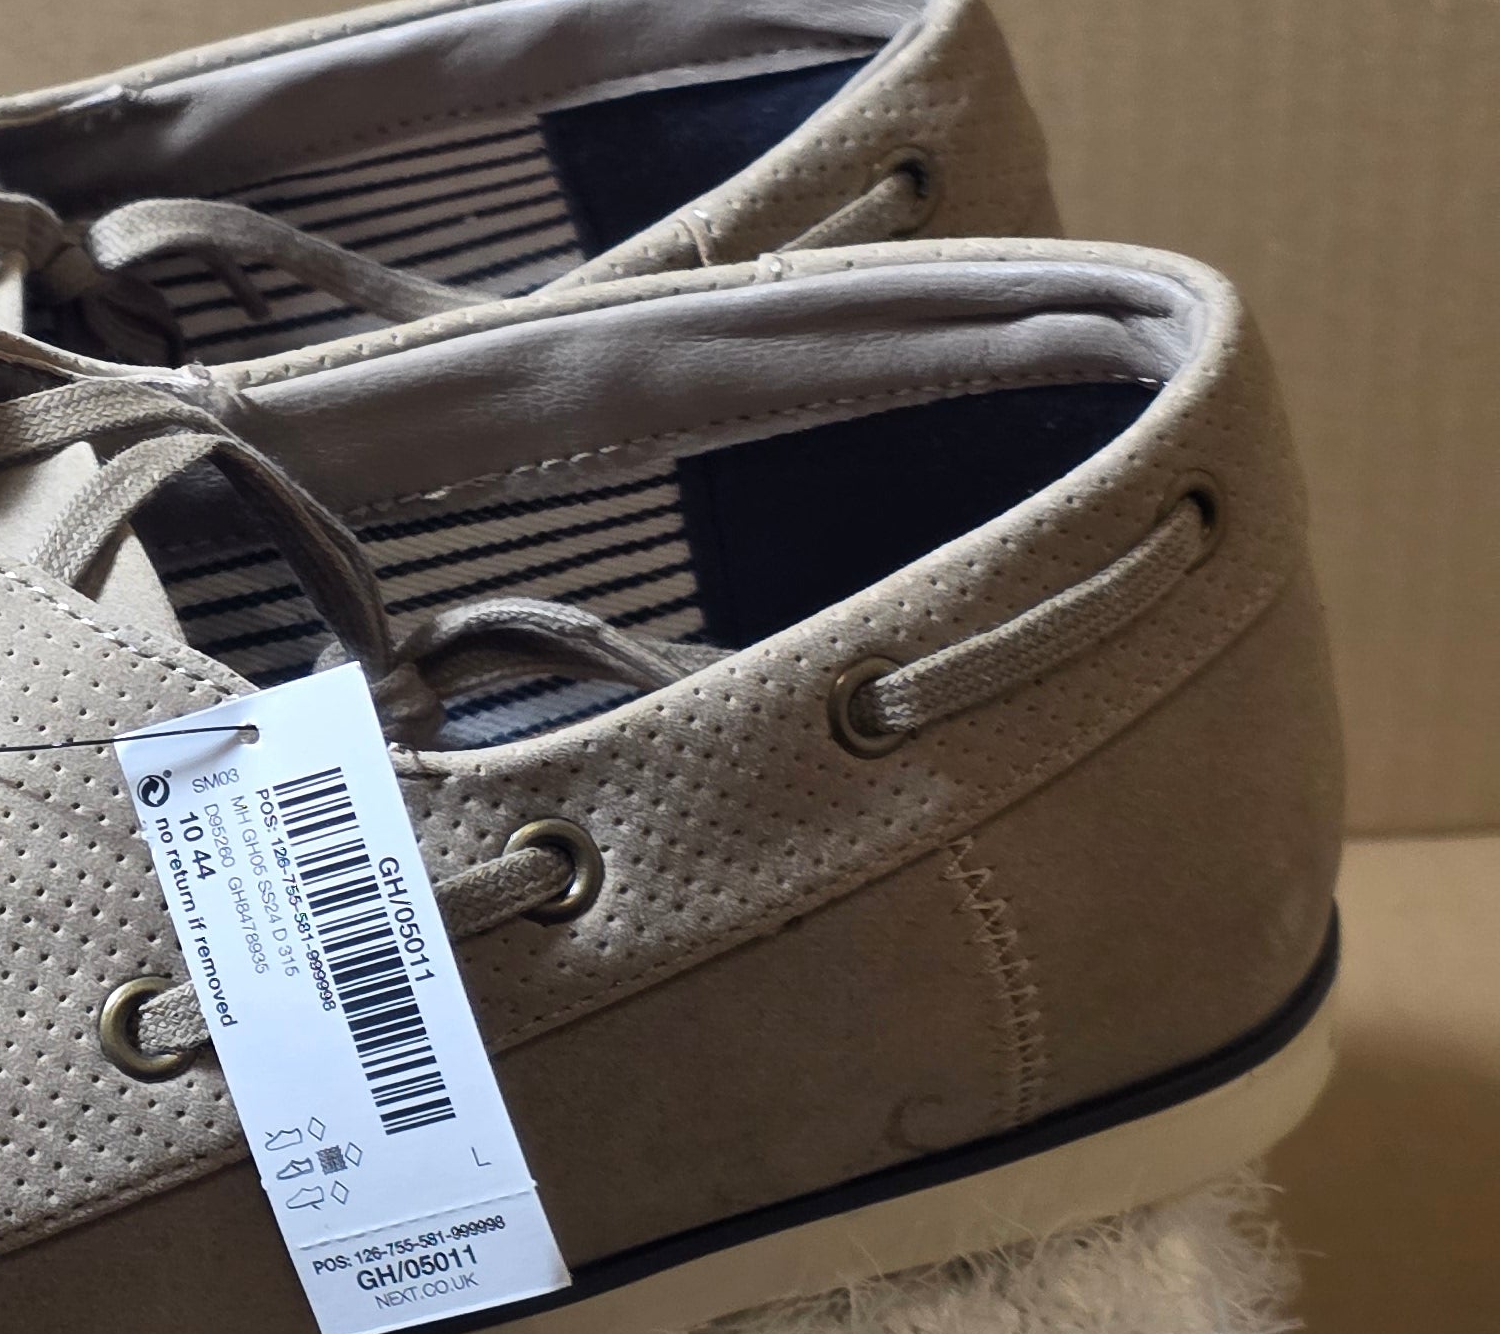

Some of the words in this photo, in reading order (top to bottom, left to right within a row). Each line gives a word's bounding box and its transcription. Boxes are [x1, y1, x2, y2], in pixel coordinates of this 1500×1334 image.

[192, 768, 240, 793] SM03
[156, 817, 174, 844] no
[179, 812, 204, 842] 10
[193, 850, 216, 880] 44
[204, 803, 235, 868] D95260
[166, 849, 196, 913] return
[231, 795, 252, 824] MH
[242, 828, 268, 876] GH05
[258, 880, 282, 924] SS24
[273, 928, 288, 942] D
[255, 789, 278, 832] POS:
[271, 837, 336, 1011] 126-755-581-999998
[188, 917, 208, 932] if
[379, 857, 436, 981] GH/05011
[194, 935, 238, 1028] removed
[312, 1255, 353, 1275] POS:
[354, 1215, 506, 1264] 126-755-581-999998
[357, 1244, 478, 1291] GH/05011
[375, 1272, 479, 1309] NEXT.CO.UK
